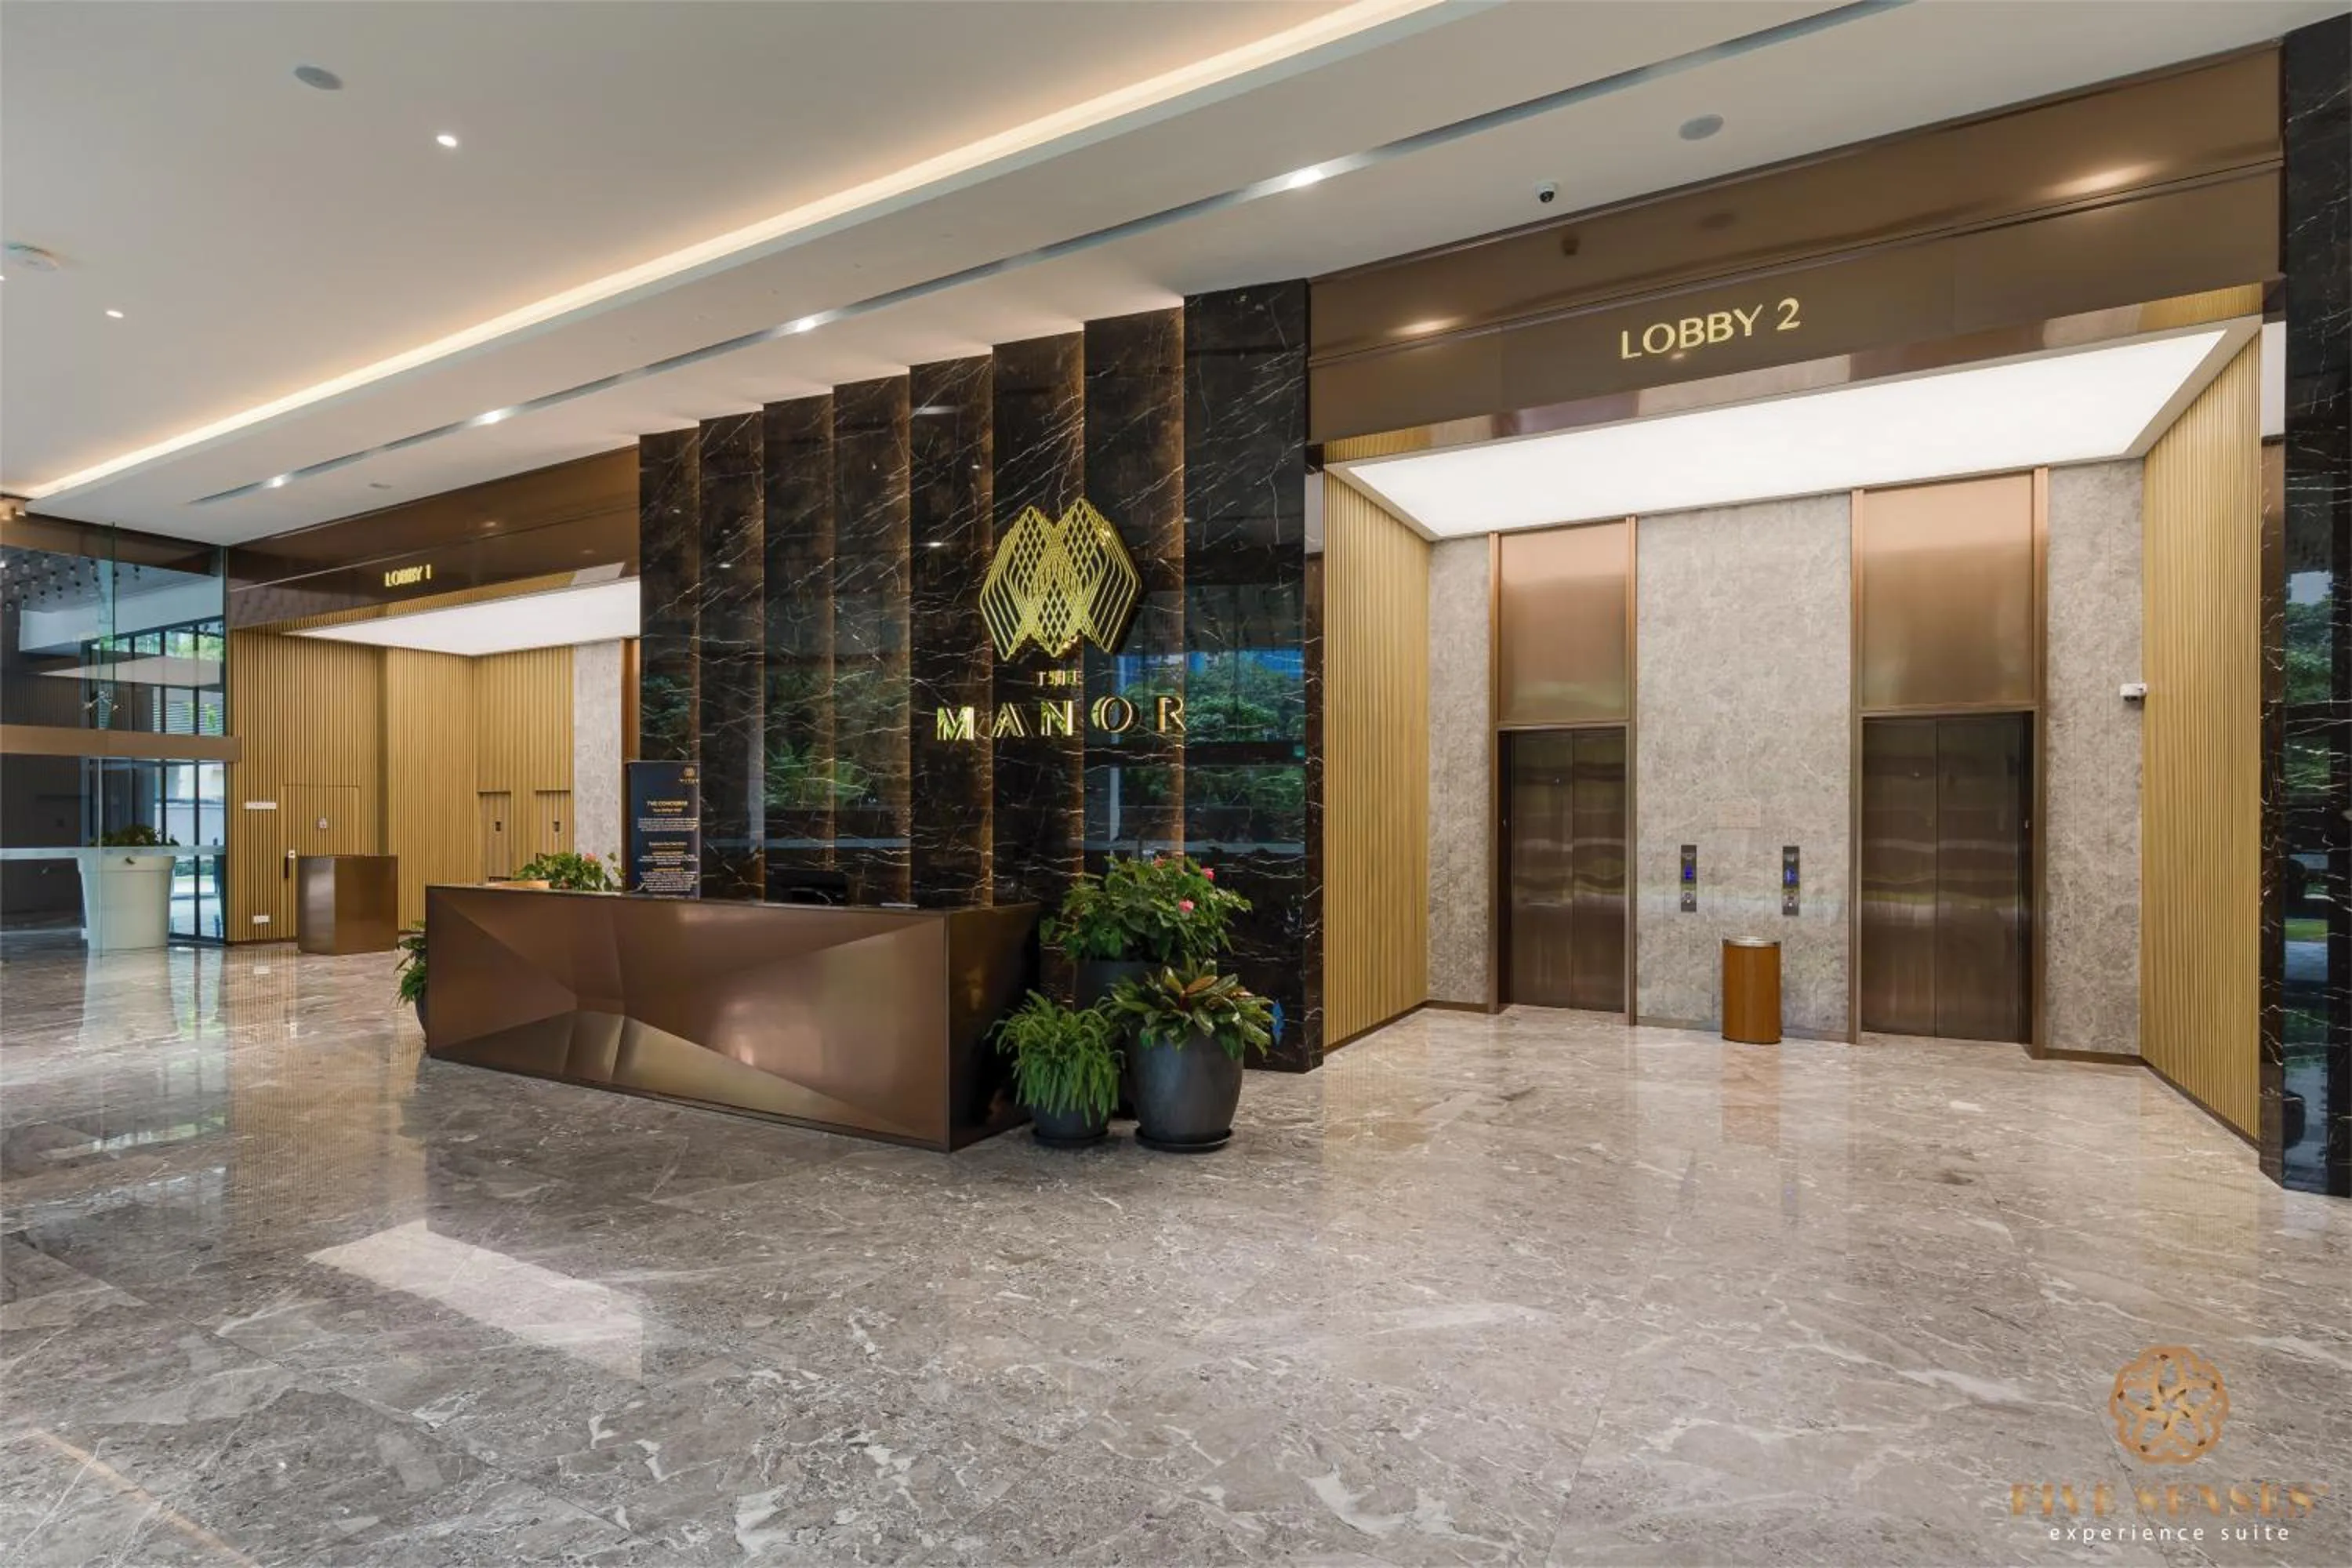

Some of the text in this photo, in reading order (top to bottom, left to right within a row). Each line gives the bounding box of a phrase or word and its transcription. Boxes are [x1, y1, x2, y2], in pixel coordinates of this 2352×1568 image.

[1621, 297, 1801, 359] LOBBY 2
[385, 564, 431, 587] LOBBY 1
[1036, 670, 1083, 687] THE
[937, 695, 1186, 741] MANOR
